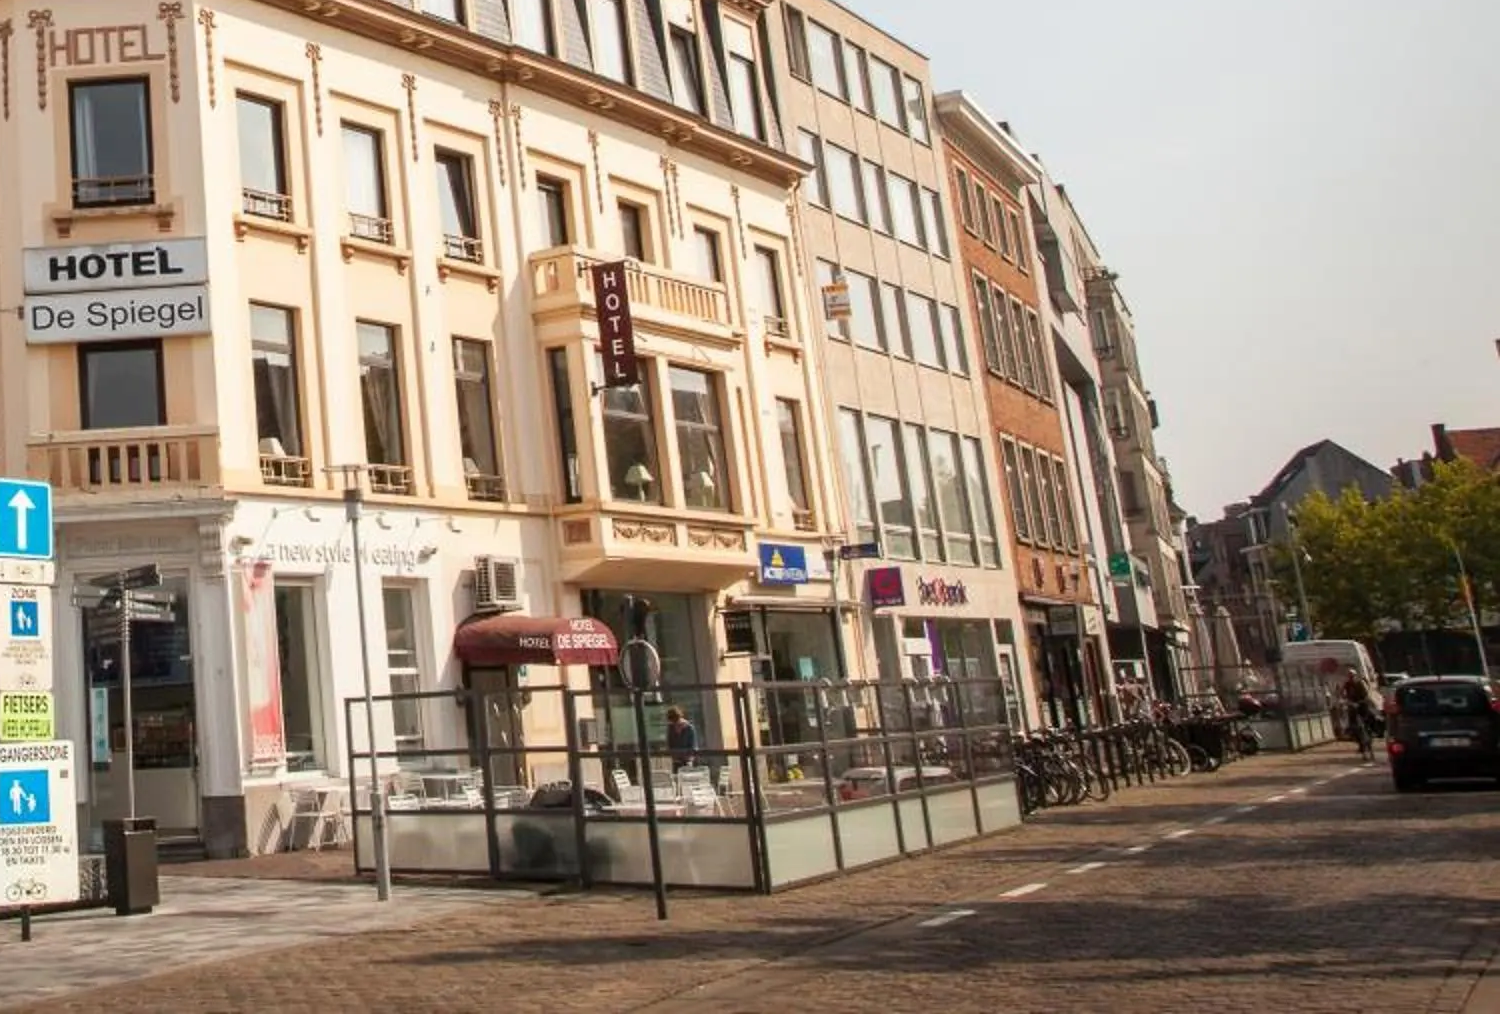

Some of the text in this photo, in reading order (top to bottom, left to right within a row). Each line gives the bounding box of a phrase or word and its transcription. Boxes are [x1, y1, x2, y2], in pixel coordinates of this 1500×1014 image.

[50, 24, 166, 67] HOTEL
[49, 246, 184, 282] HOTEL
[32, 296, 203, 331] De Spiegel
[603, 271, 627, 378] HOTEL
[279, 543, 313, 563] new
[315, 538, 350, 563] style
[11, 587, 36, 599] ZONE
[570, 619, 595, 632] HOTEL
[519, 637, 551, 649] HOTEL
[557, 634, 611, 649] DE SPIEGEL
[4, 695, 48, 713] FIETSERS
